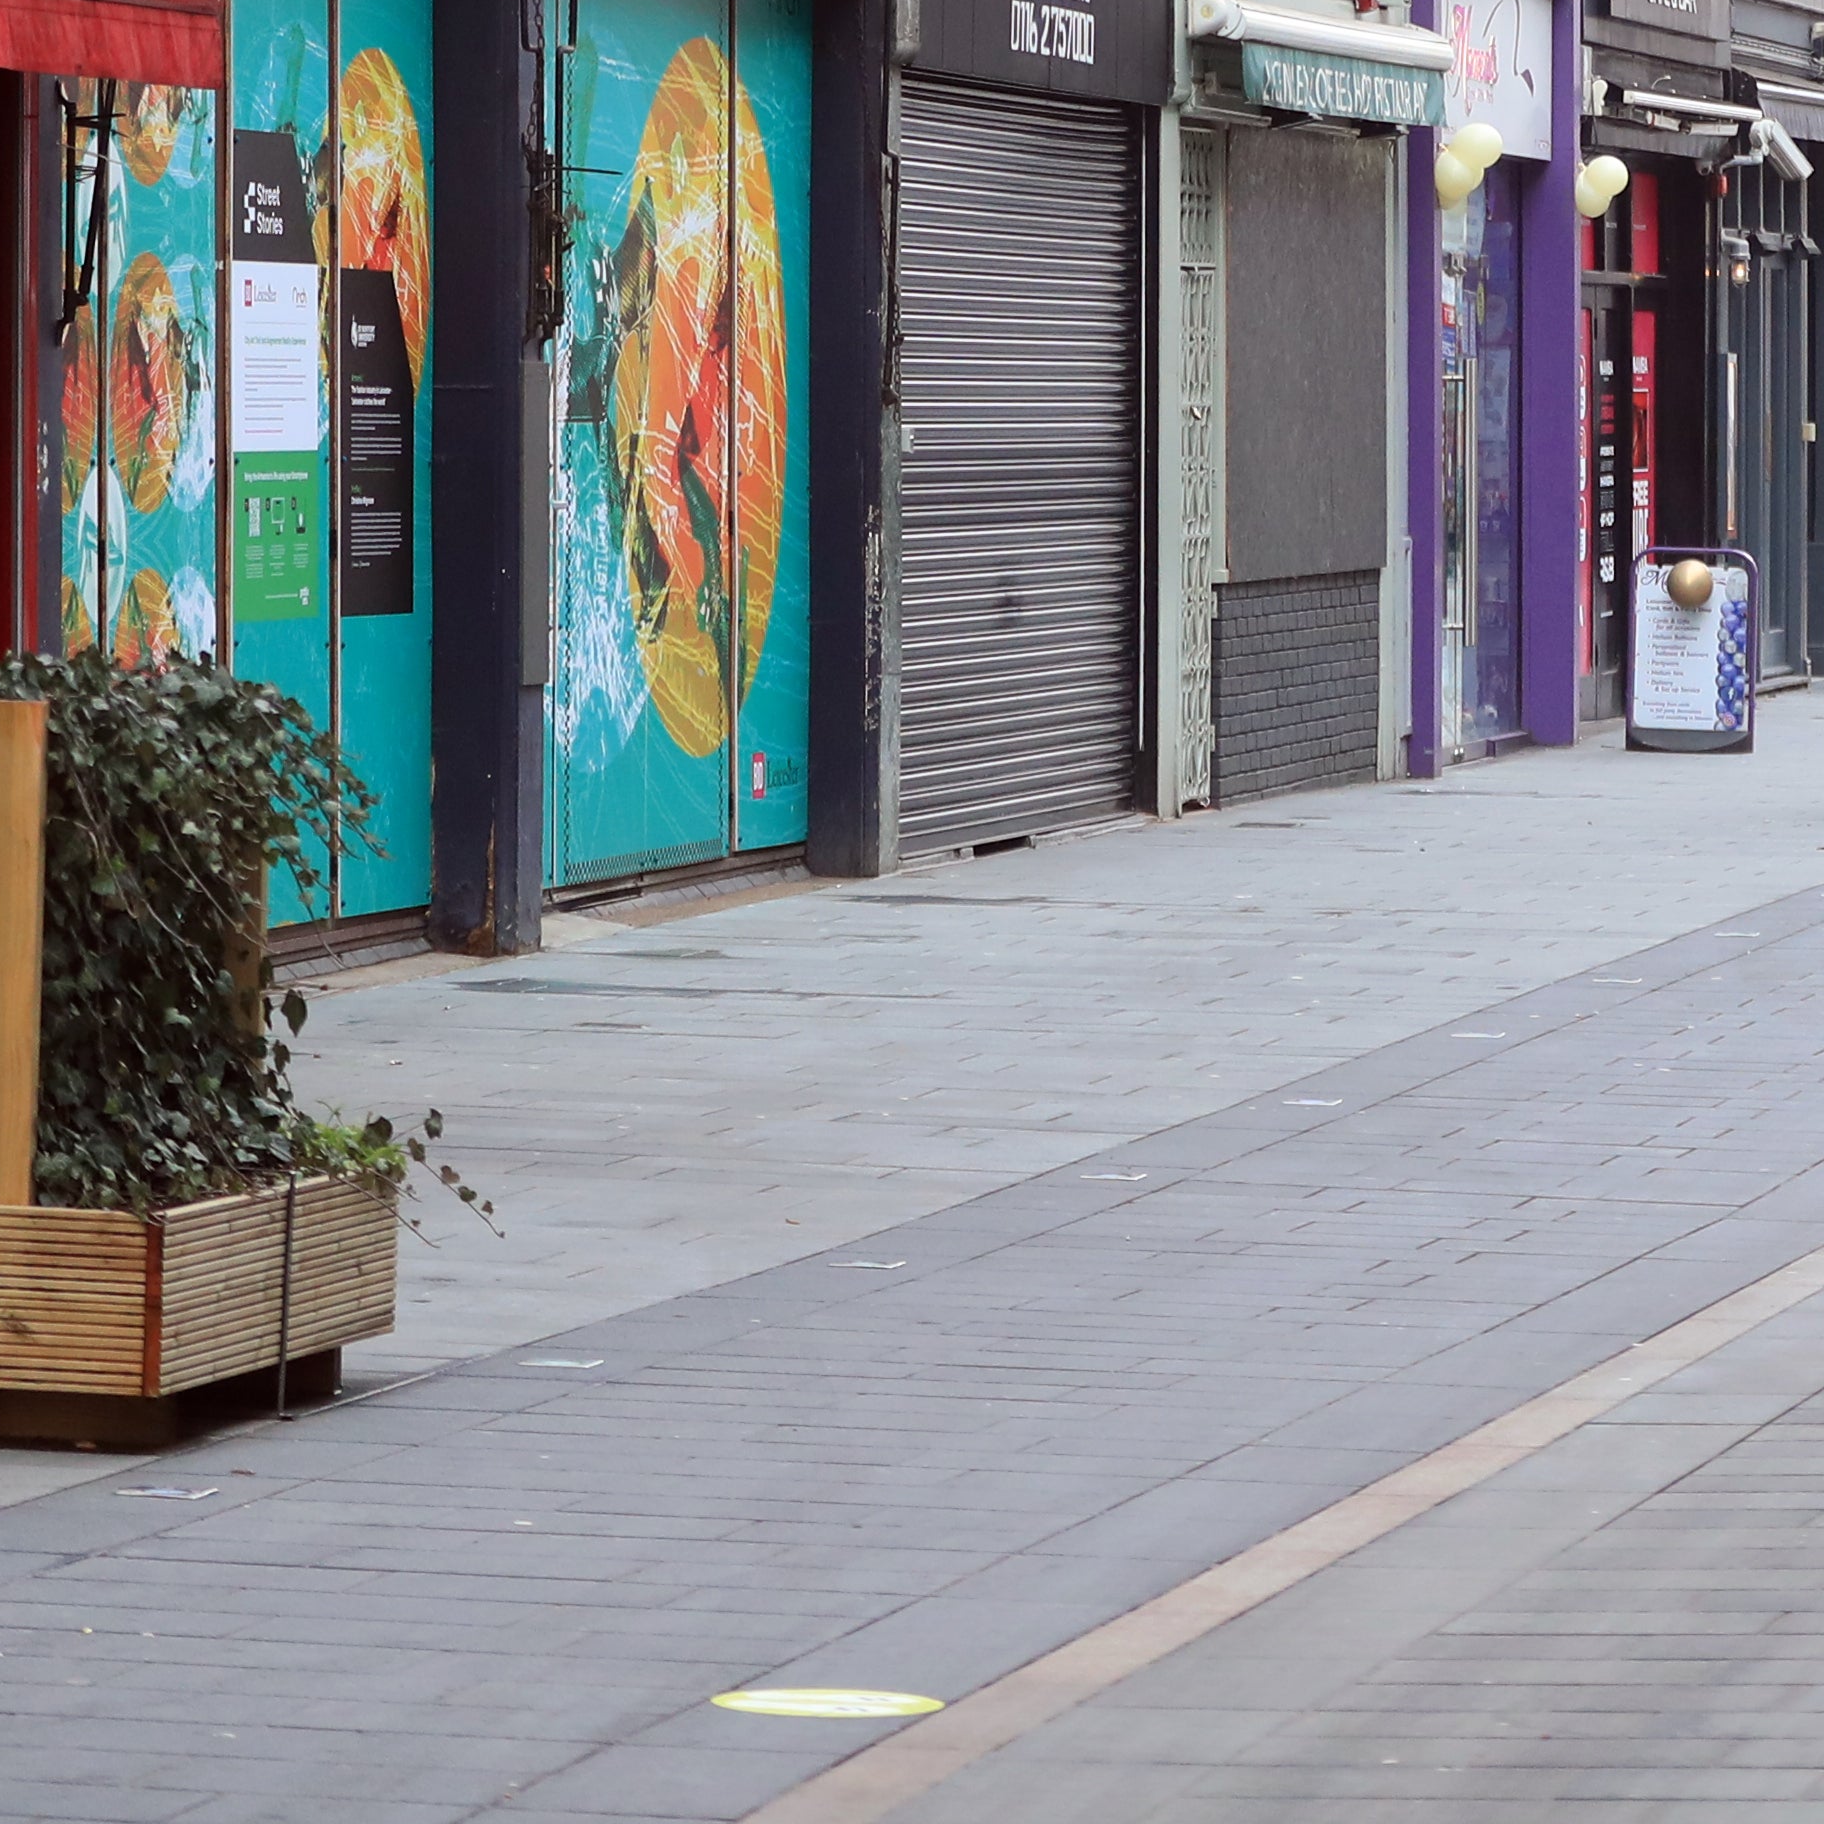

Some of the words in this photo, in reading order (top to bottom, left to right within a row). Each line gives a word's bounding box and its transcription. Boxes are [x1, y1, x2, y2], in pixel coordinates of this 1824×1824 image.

[1011, 0, 1038, 54] 0116
[256, 183, 280, 207] Street
[256, 212, 283, 236] Stories
